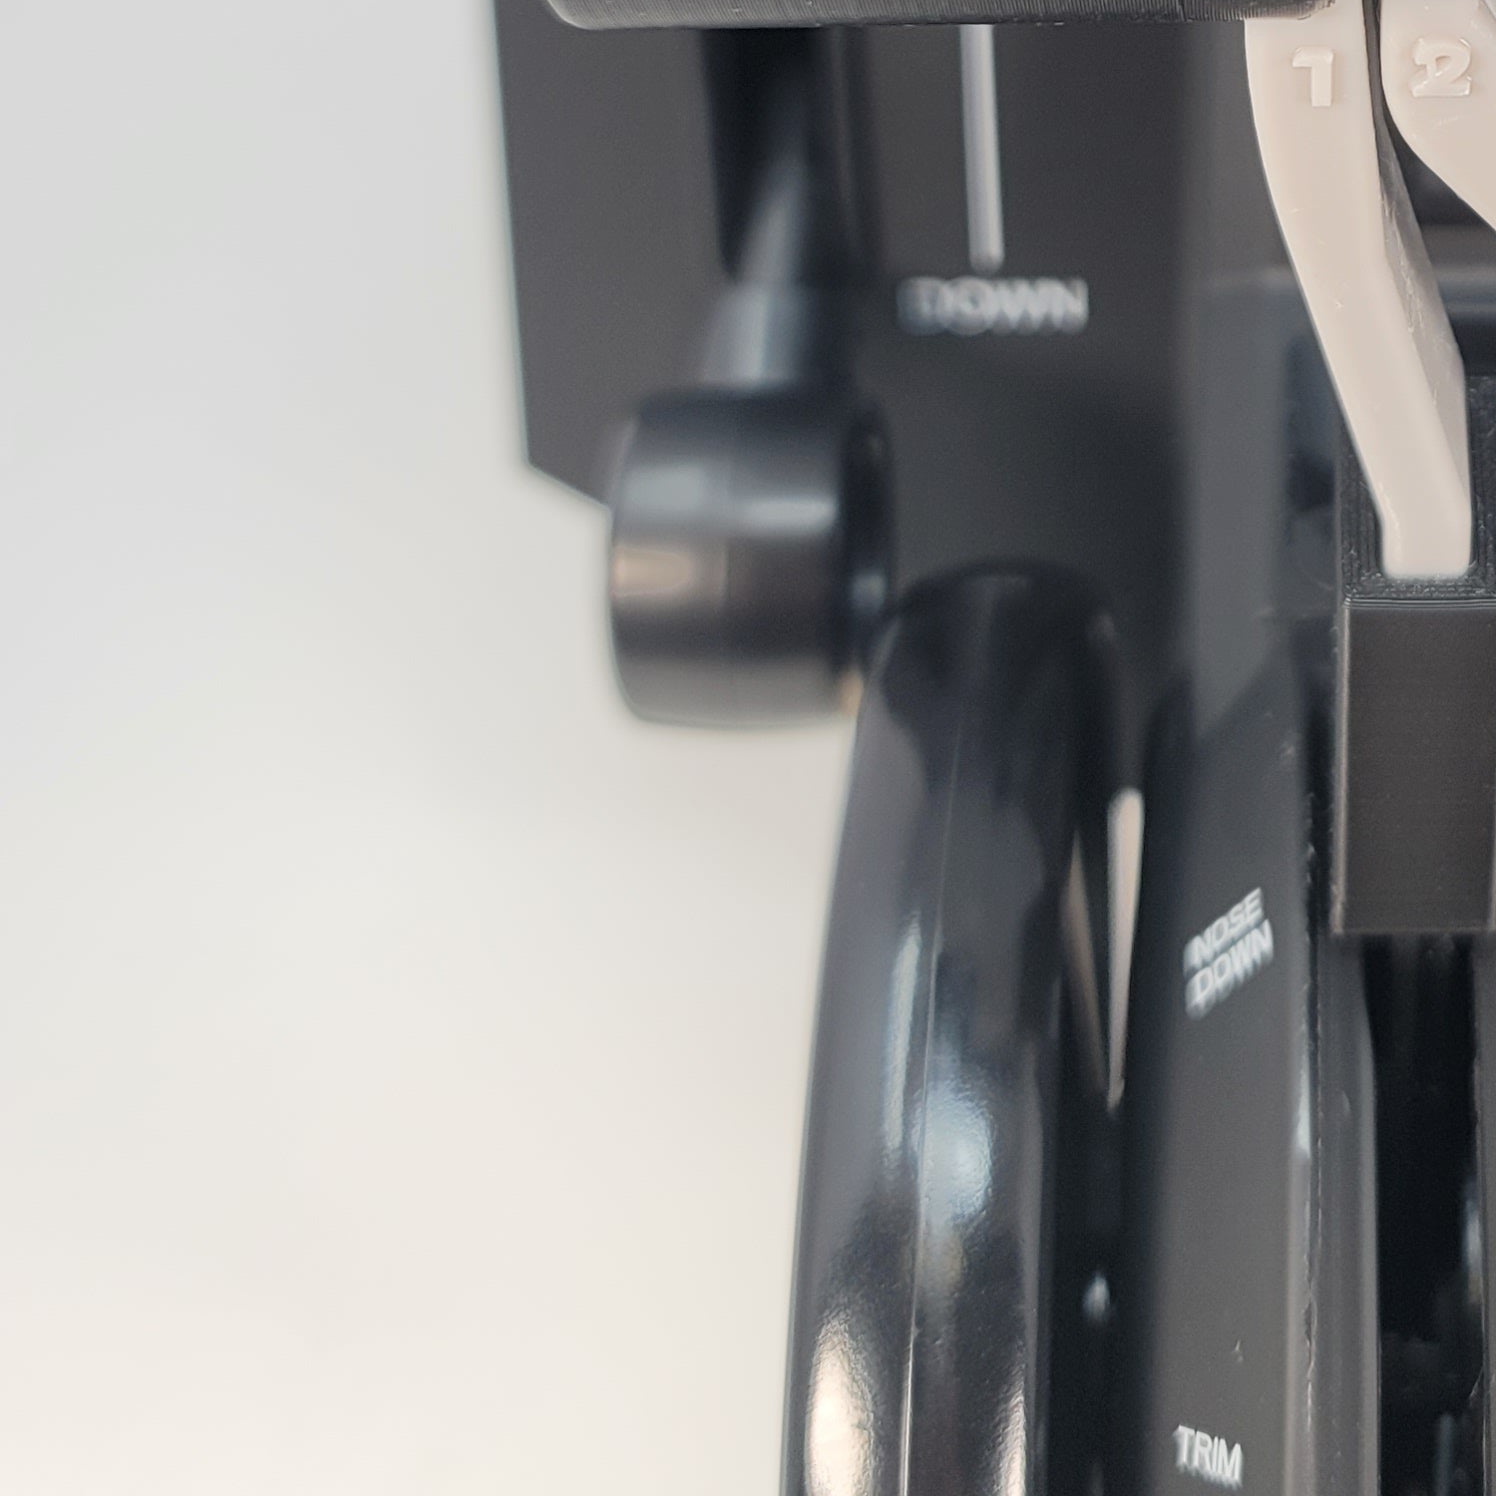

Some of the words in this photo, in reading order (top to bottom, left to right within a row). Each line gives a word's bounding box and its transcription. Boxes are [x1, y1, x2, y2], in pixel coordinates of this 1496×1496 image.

[1293, 46, 1333, 106] 1
[1412, 37, 1471, 97] 2
[897, 276, 1089, 336] DOWN
[1183, 887, 1264, 978] NOSE
[1185, 918, 1274, 1020] DOWN
[1173, 1424, 1243, 1490] TRIM
